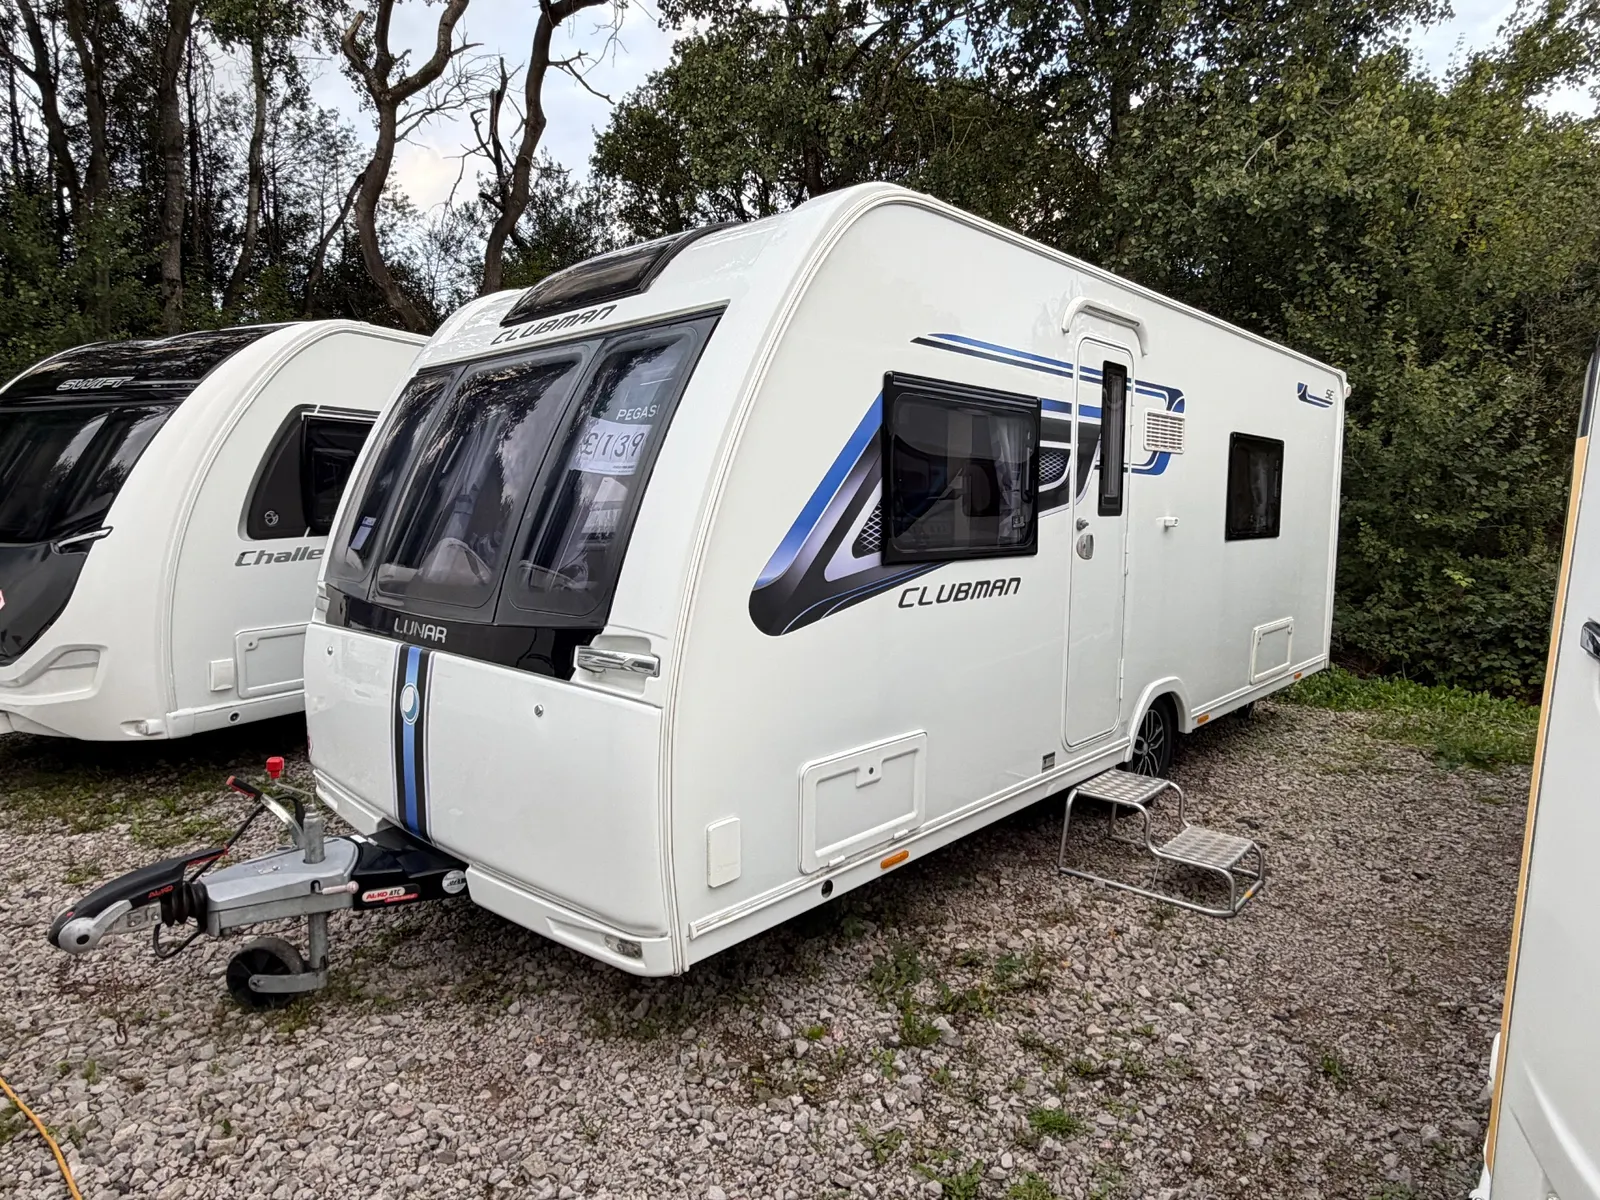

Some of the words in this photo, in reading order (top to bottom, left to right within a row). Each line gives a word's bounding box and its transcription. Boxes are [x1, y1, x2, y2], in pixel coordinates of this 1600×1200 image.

[490, 304, 617, 345] CLUBMAN
[56, 376, 135, 391] SWIFT
[616, 404, 660, 420] PEGAS
[897, 577, 1022, 608] CLUBMAN
[393, 617, 448, 643] LUNAR
